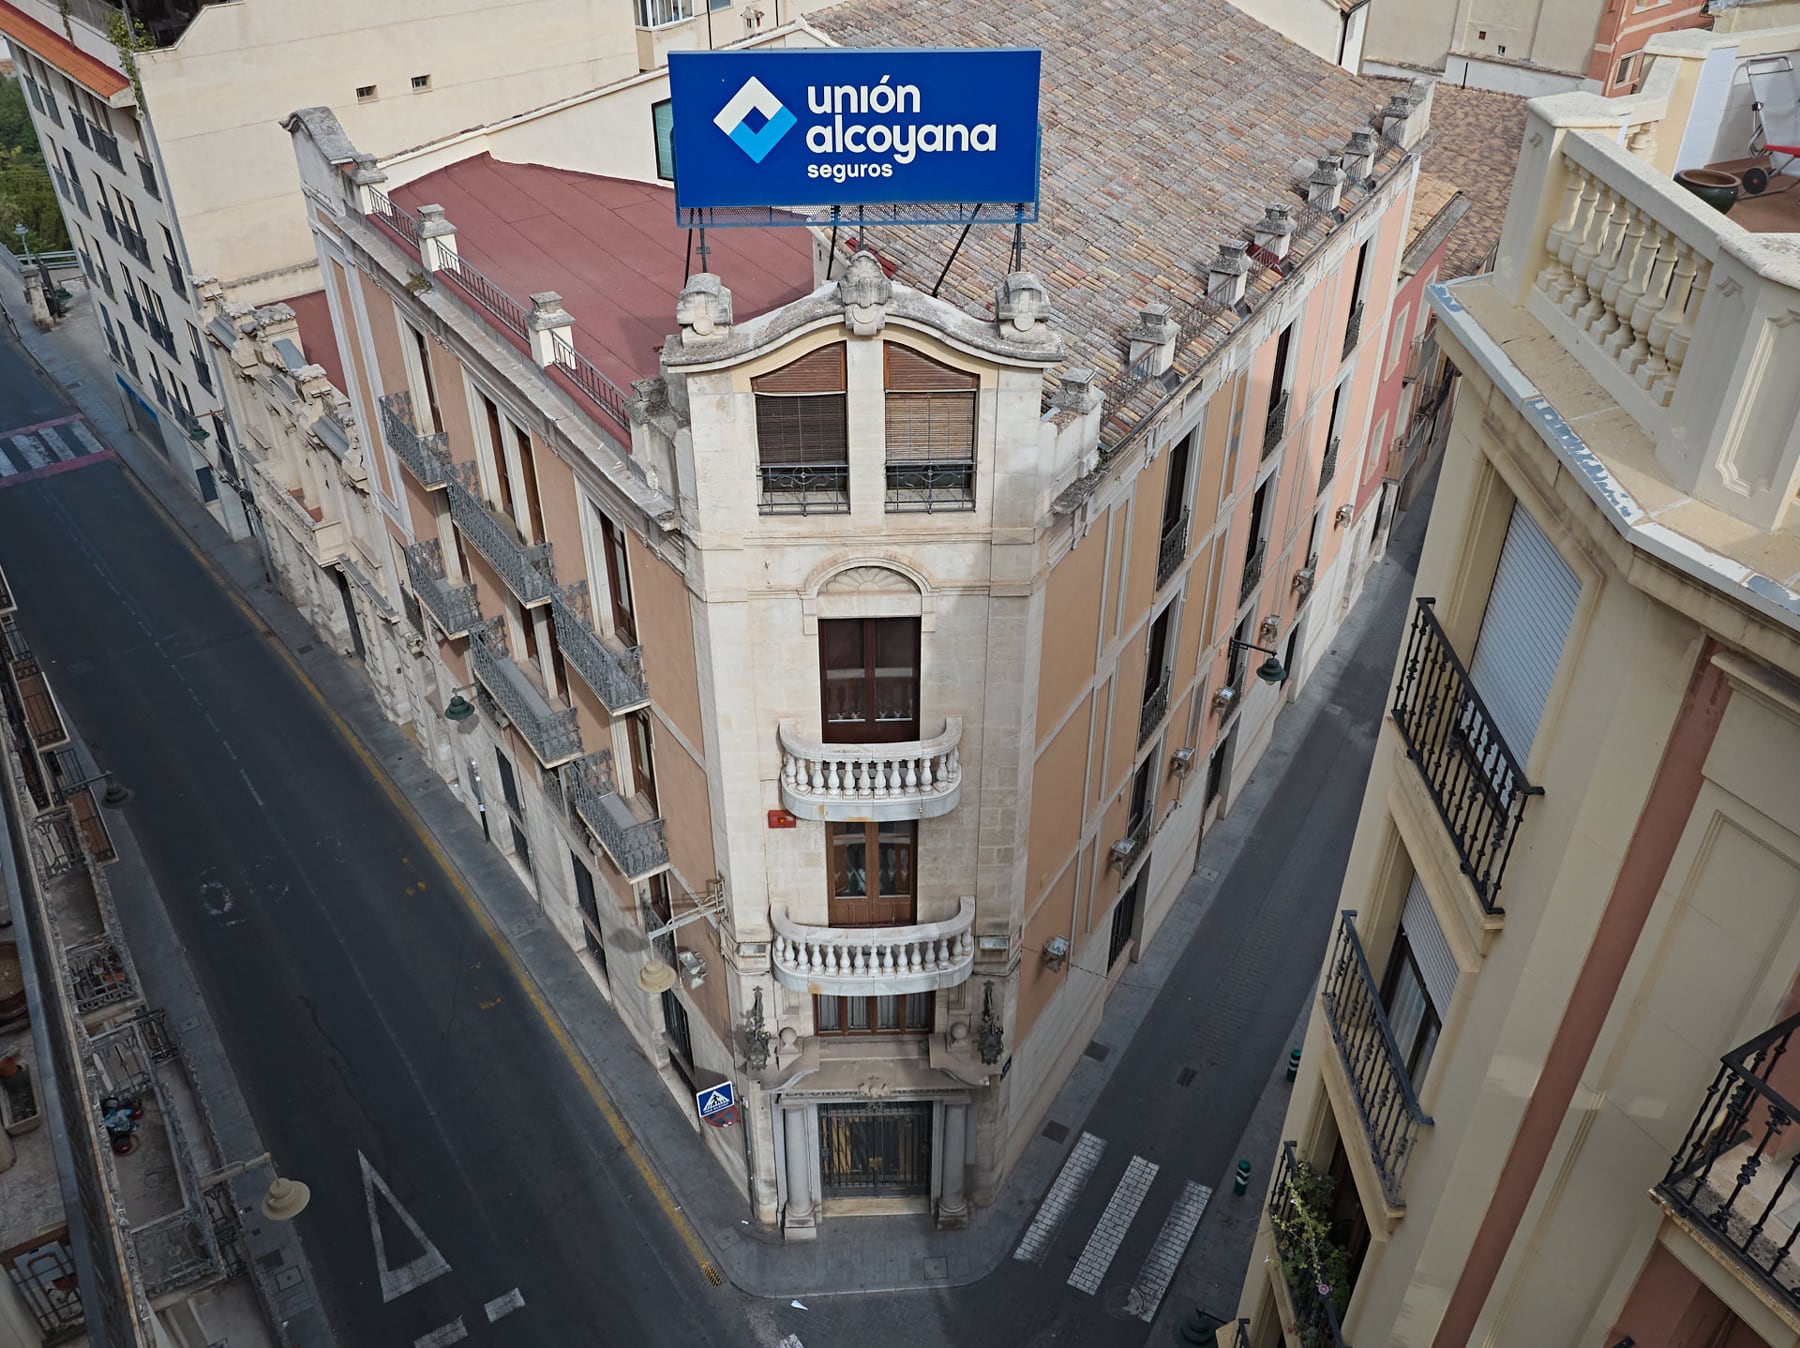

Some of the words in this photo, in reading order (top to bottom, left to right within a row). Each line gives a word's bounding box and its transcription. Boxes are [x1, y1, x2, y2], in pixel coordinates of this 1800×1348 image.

[807, 74, 921, 115] unión
[805, 114, 997, 165] alcoyana
[807, 163, 893, 184] seguros
